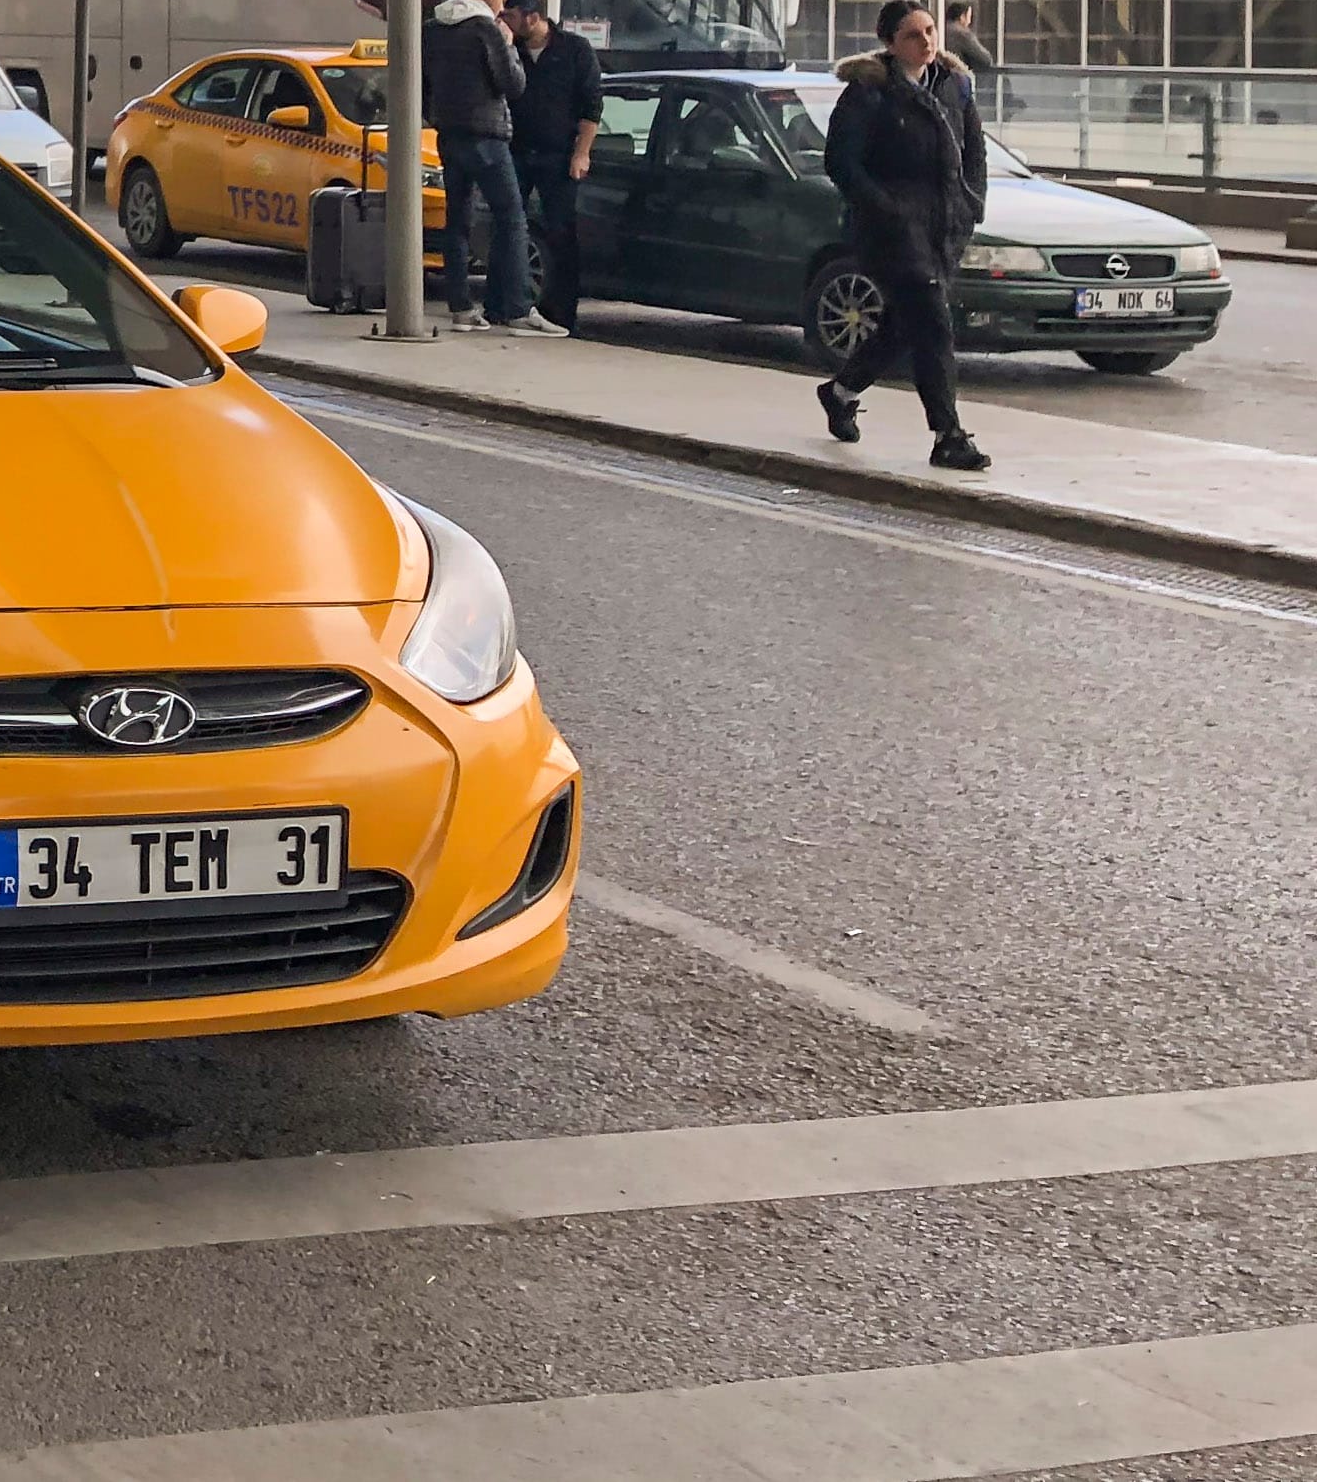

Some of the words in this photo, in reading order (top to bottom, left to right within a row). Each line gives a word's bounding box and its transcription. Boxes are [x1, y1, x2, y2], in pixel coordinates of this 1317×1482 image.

[1085, 292, 1102, 309] 34
[1118, 291, 1143, 309] NDK
[1155, 291, 1172, 308] 64
[28, 837, 93, 900] 34
[131, 829, 229, 895] TEM
[277, 825, 331, 886] 31
